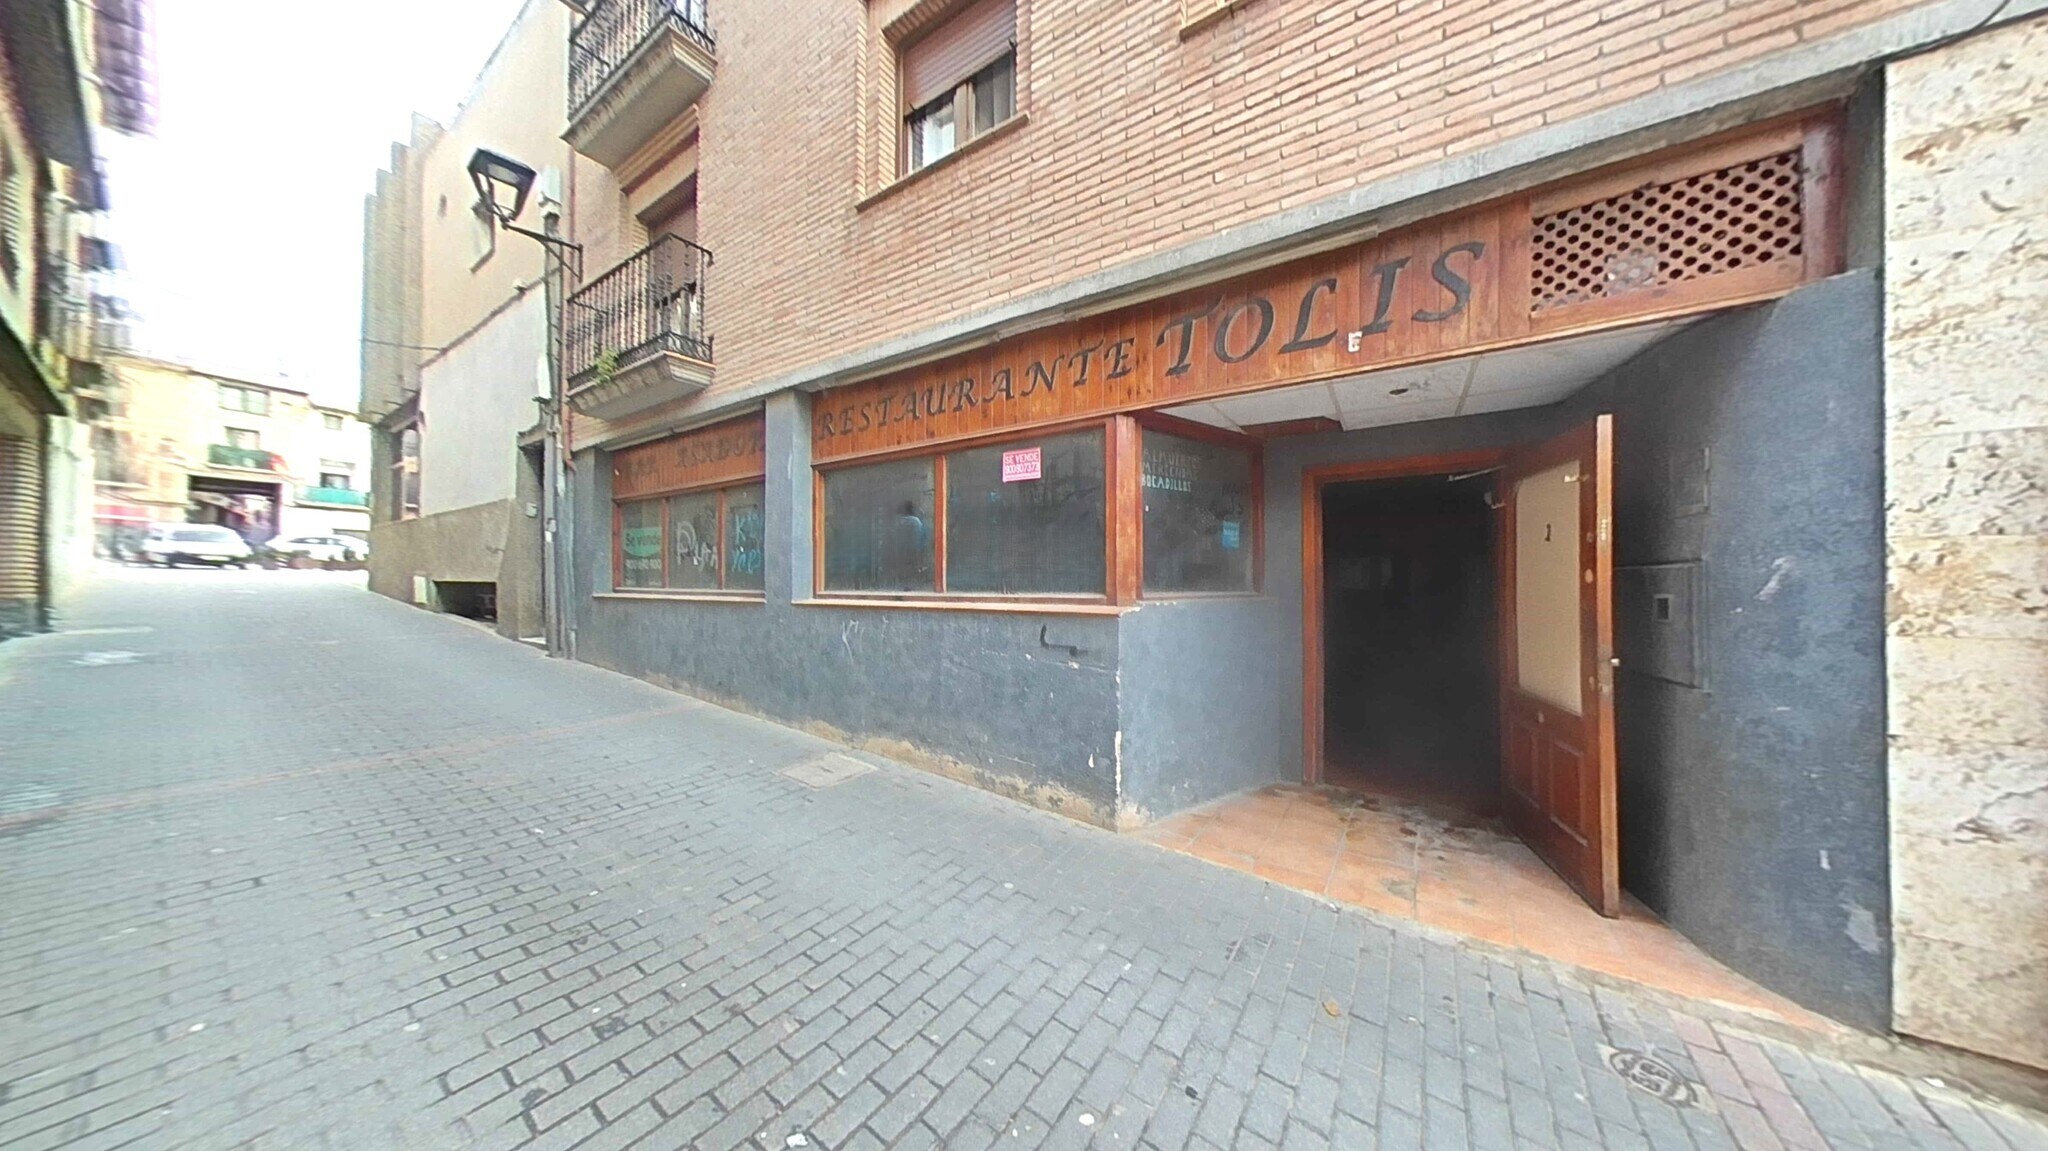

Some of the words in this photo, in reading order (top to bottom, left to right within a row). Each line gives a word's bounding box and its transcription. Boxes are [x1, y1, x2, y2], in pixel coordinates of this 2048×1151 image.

[816, 338, 1136, 440] RESTAURANTE
[1156, 241, 1486, 377] TOLIS
[1005, 455, 1015, 465] SE
[1015, 452, 1039, 463] VENDE
